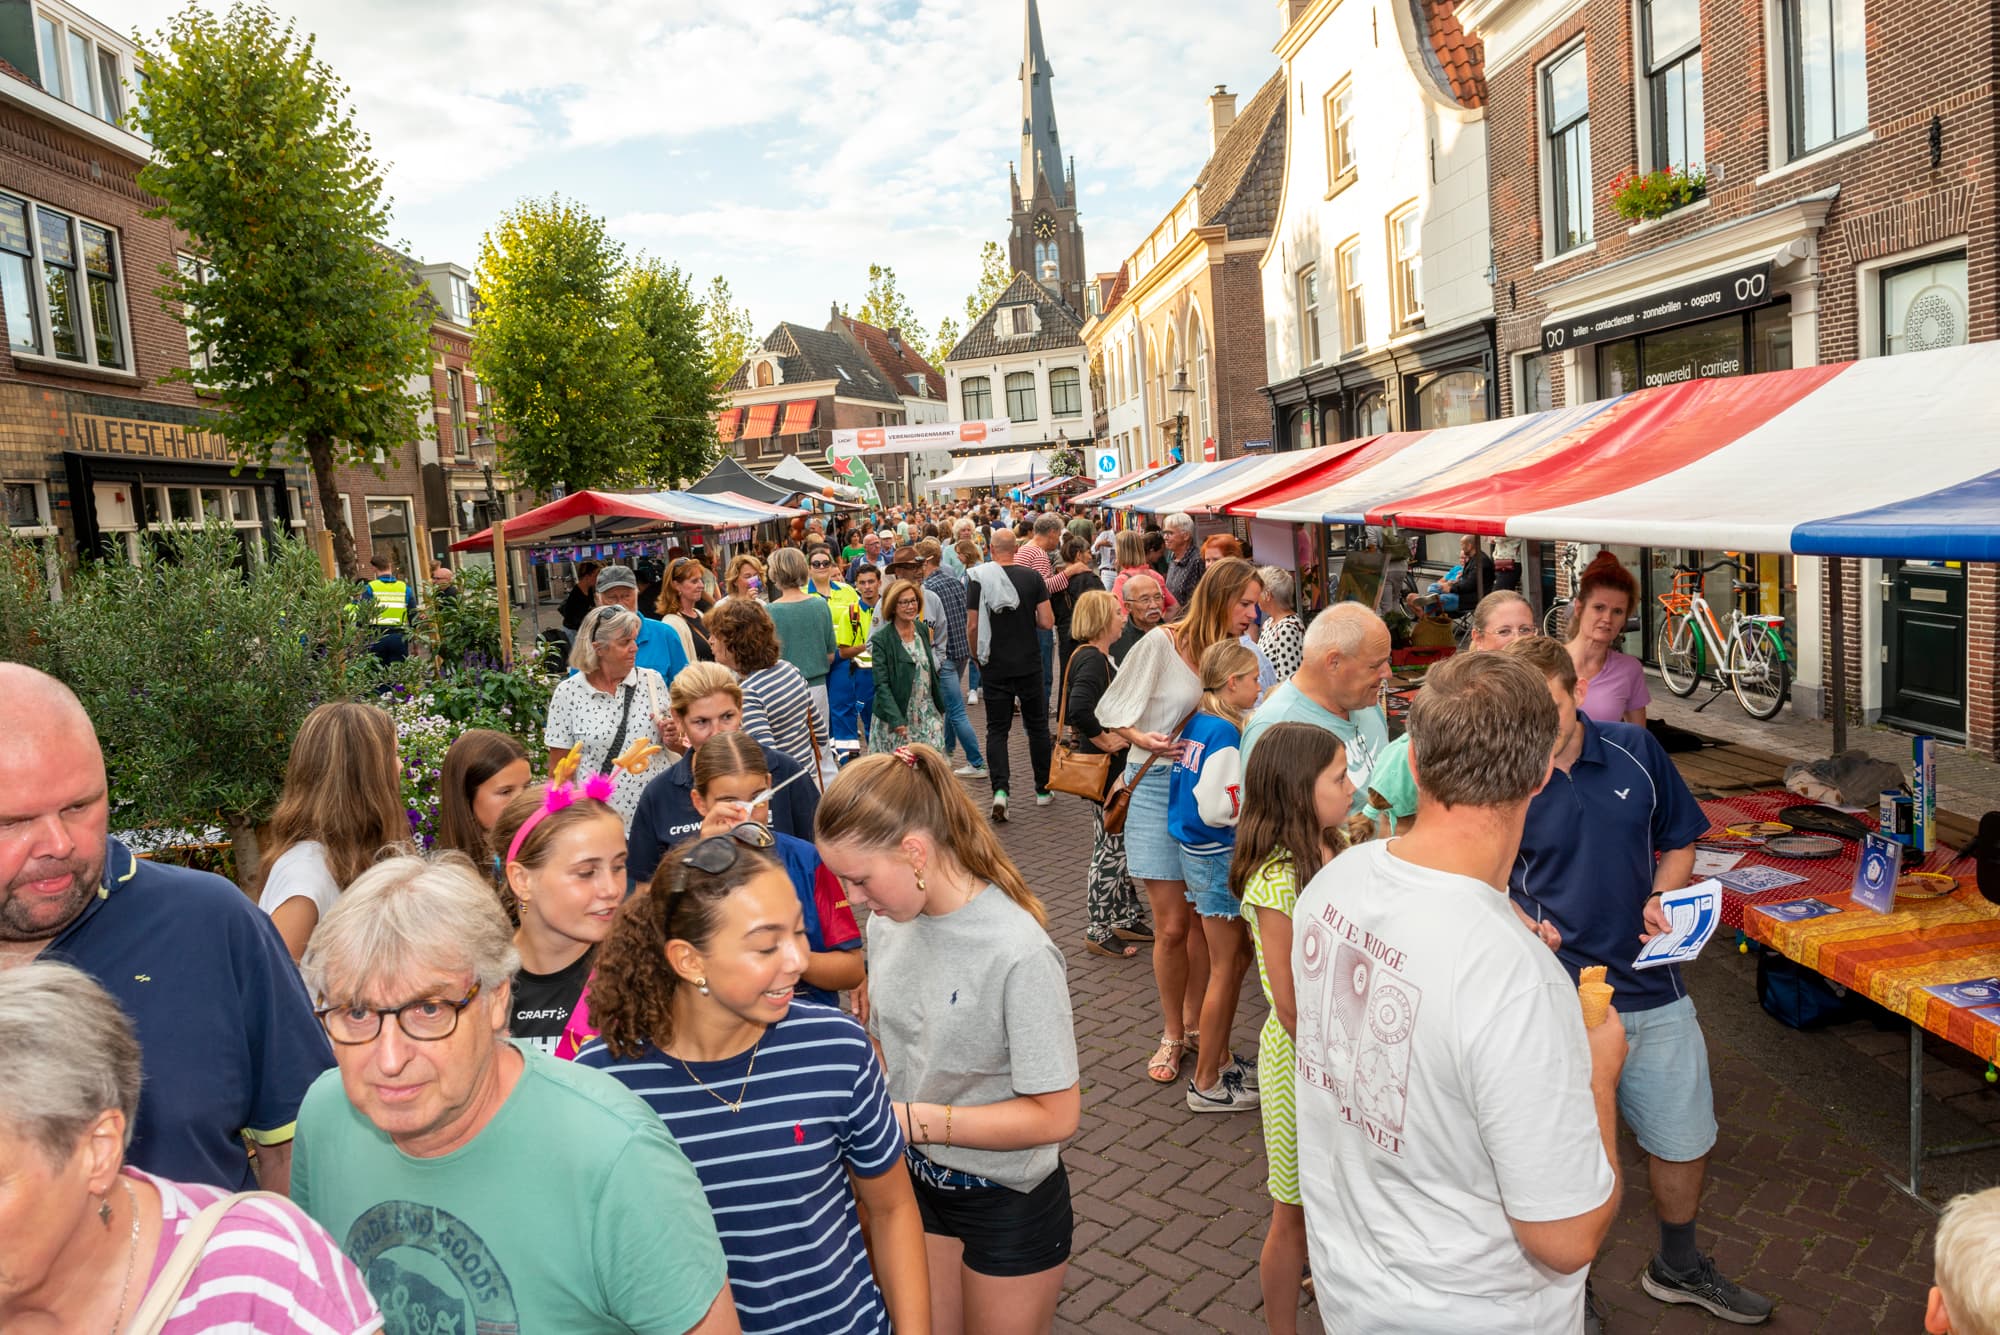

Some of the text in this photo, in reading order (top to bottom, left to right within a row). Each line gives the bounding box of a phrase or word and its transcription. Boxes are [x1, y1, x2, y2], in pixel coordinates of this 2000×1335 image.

[1573, 325, 1589, 337] brillen
[1595, 313, 1635, 331] contactlenzen
[1642, 301, 1682, 319] zonnebrillen
[1690, 291, 1721, 308] oogzorg
[1645, 364, 1691, 387] oogwereld
[1912, 786, 1922, 827] YONEX
[669, 821, 704, 836] crew
[1322, 903, 1408, 973] BLUE RIDGE
[517, 1009, 557, 1020] CRAFT
[1297, 1056, 1317, 1084] HE
[438, 1226, 499, 1304] GOODS
